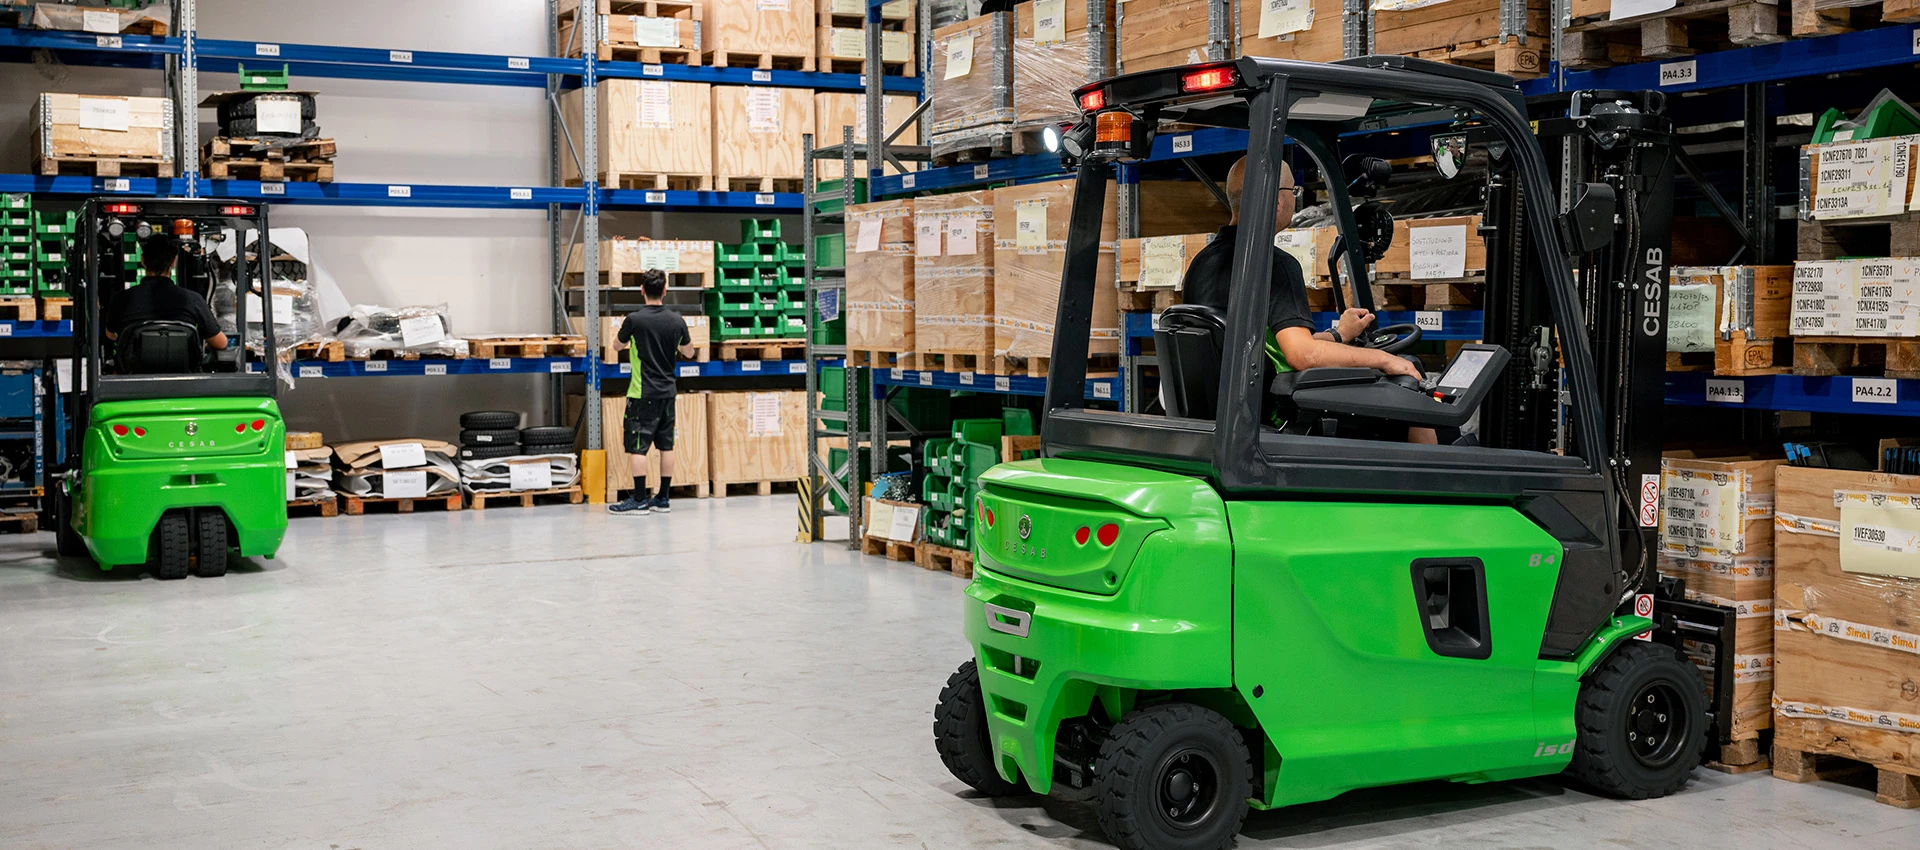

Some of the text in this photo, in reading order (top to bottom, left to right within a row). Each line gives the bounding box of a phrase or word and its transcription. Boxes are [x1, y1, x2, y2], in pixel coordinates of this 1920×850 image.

[1520, 53, 1537, 66] EPAL
[1662, 68, 1692, 80] PA4.3.3
[1174, 140, 1191, 148] PA5.3.3
[1822, 147, 1868, 162] 1CNF27670 7021
[1895, 141, 1907, 178] 1CNF41790
[1820, 169, 1851, 181] 1CNF29311
[1794, 267, 1823, 278] 1CNF32170
[1861, 265, 1893, 277] 1CNF35781
[1643, 247, 1662, 337] CESAB
[1860, 286, 1893, 298] 1CNF41763
[1857, 300, 1889, 312] 1CNX41525
[1417, 317, 1439, 326] PA5.2.1
[1855, 318, 1887, 329] 1CNF41780
[1709, 386, 1740, 397] PA4.1.3
[1855, 386, 1892, 397] PA4.2.2
[168, 440, 216, 448] CESAB
[1747, 506, 1768, 516] Simai
[1854, 527, 1886, 542] 1VEF30530
[1005, 541, 1046, 558] CESAB
[1752, 603, 1772, 613] Simai
[1846, 626, 1871, 640] Simai
[1891, 634, 1917, 649] Simai
[1848, 711, 1873, 723] Simai
[1534, 738, 1576, 758] isd
